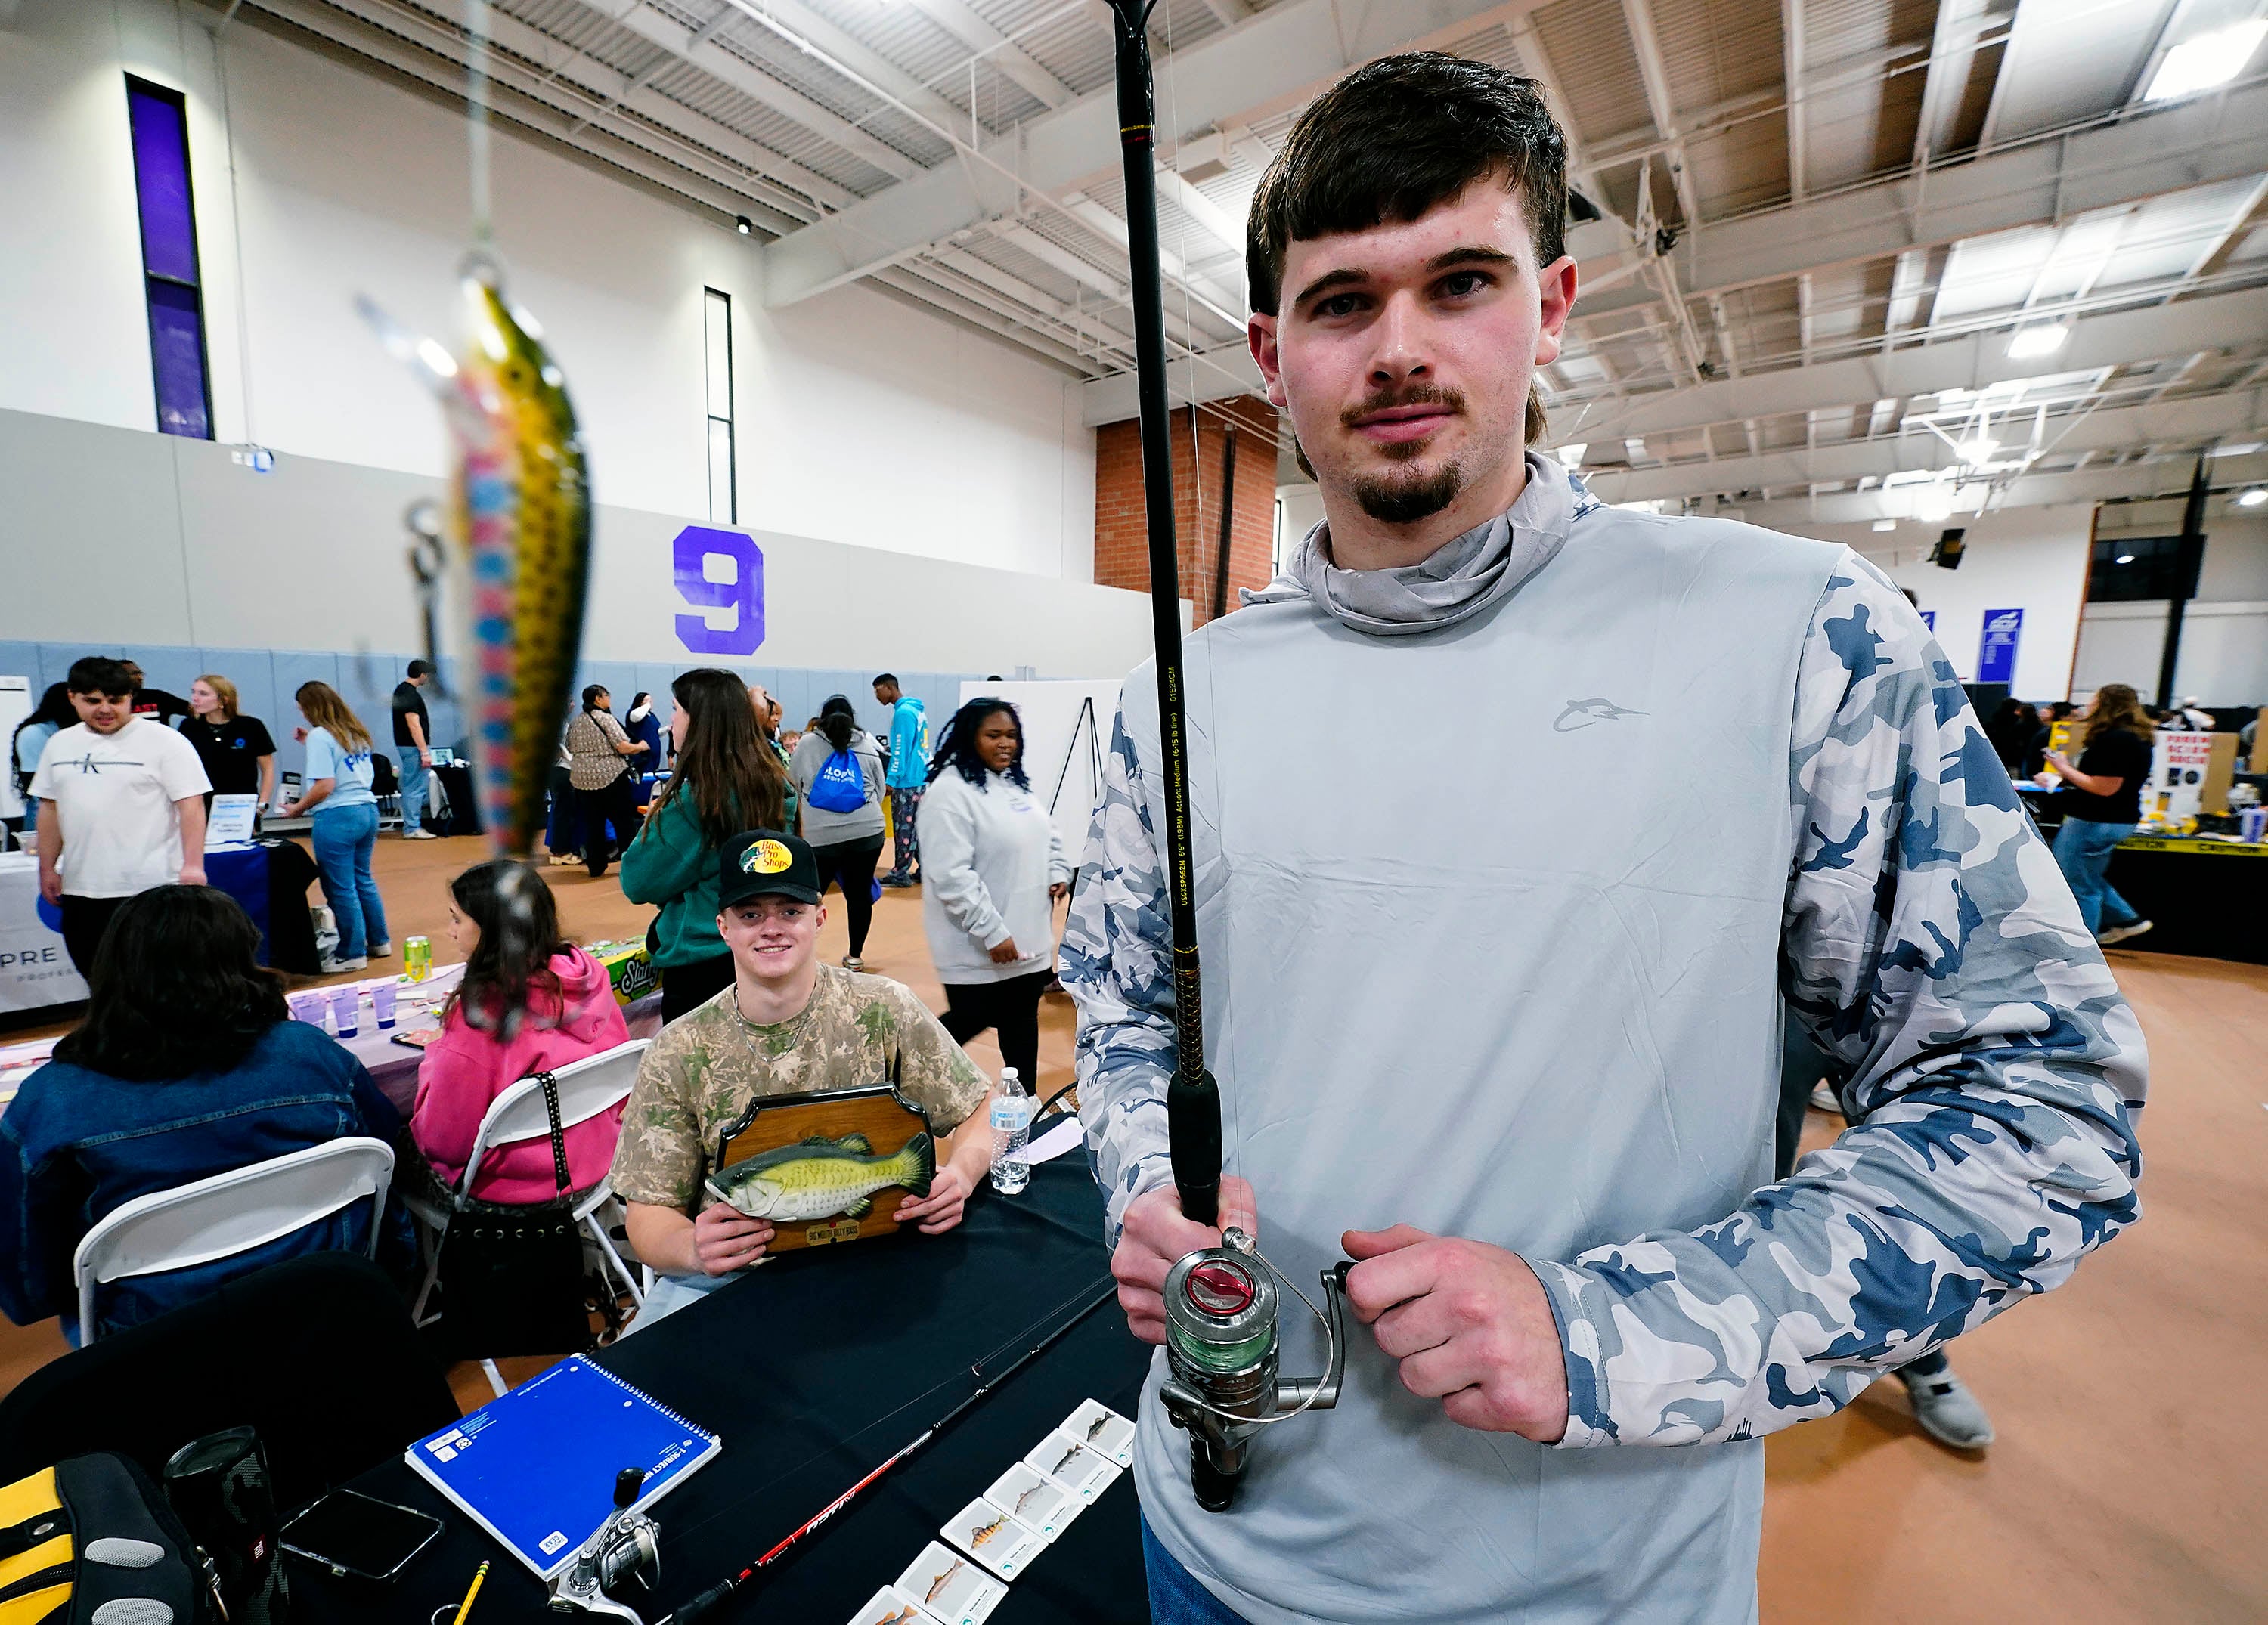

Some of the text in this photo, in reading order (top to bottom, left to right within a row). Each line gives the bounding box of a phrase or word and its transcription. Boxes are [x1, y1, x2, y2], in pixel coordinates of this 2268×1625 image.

[673, 525, 765, 656] 9
[762, 840, 782, 850] Bass
[763, 850, 778, 859] Pro
[764, 858, 789, 868] Shops
[0, 947, 57, 968] PRE
[652, 1448, 686, 1474] 1-SUBJECT
